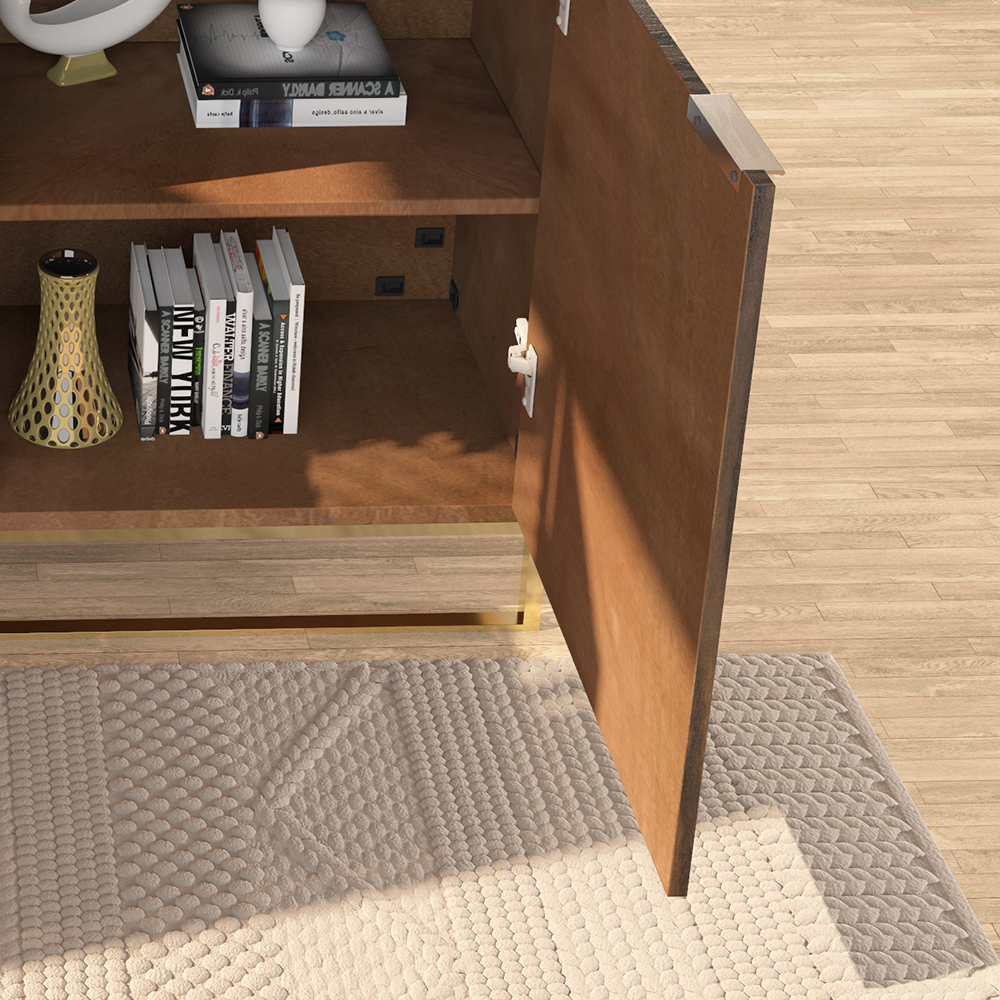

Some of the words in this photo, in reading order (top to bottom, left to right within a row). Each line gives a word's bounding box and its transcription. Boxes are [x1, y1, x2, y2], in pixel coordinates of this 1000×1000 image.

[160, 319, 170, 354] SCANNER
[174, 307, 194, 360] NEW
[223, 312, 236, 361] WALTER
[256, 331, 269, 363] SCANNER
[159, 356, 169, 384] DARKLY
[277, 345, 285, 369] Expansion
[221, 363, 233, 415] FINANCE
[256, 365, 268, 392] DARKLY
[144, 396, 153, 425] Photography
[255, 405, 263, 415] Philip
